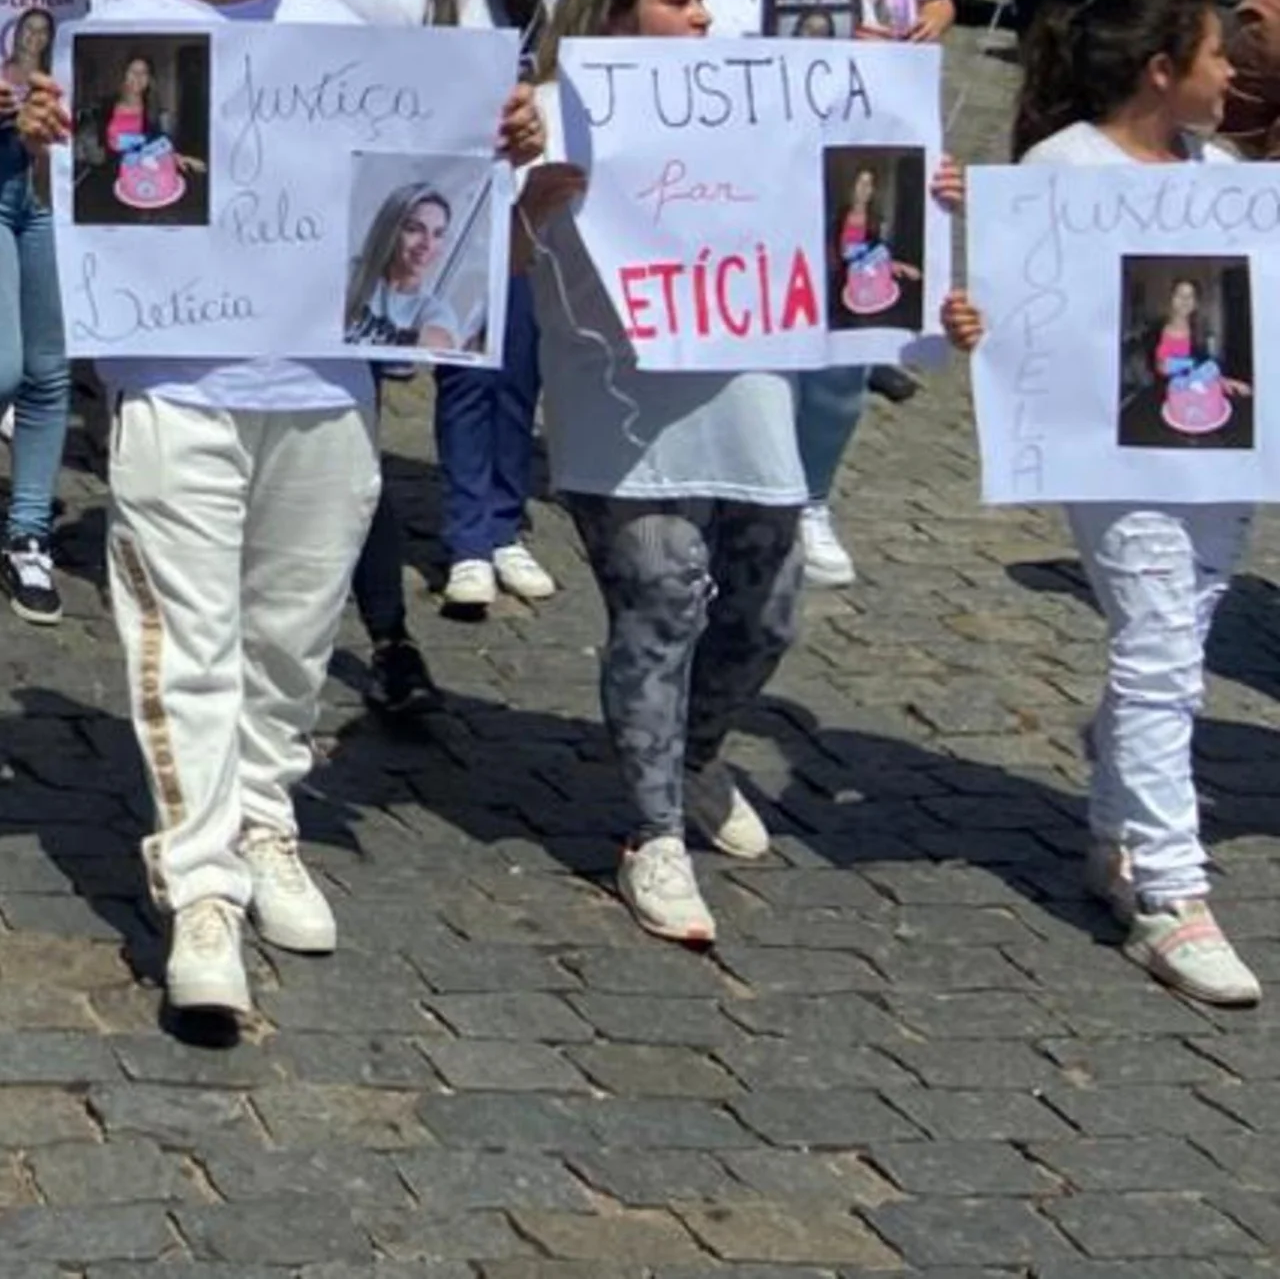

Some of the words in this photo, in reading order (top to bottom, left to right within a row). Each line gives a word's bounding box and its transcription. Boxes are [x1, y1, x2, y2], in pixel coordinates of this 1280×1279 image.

[222, 53, 433, 187] Justiça
[223, 187, 323, 247] Pela
[1011, 175, 1279, 287] Justiça
[617, 243, 820, 340] ETÍCIA
